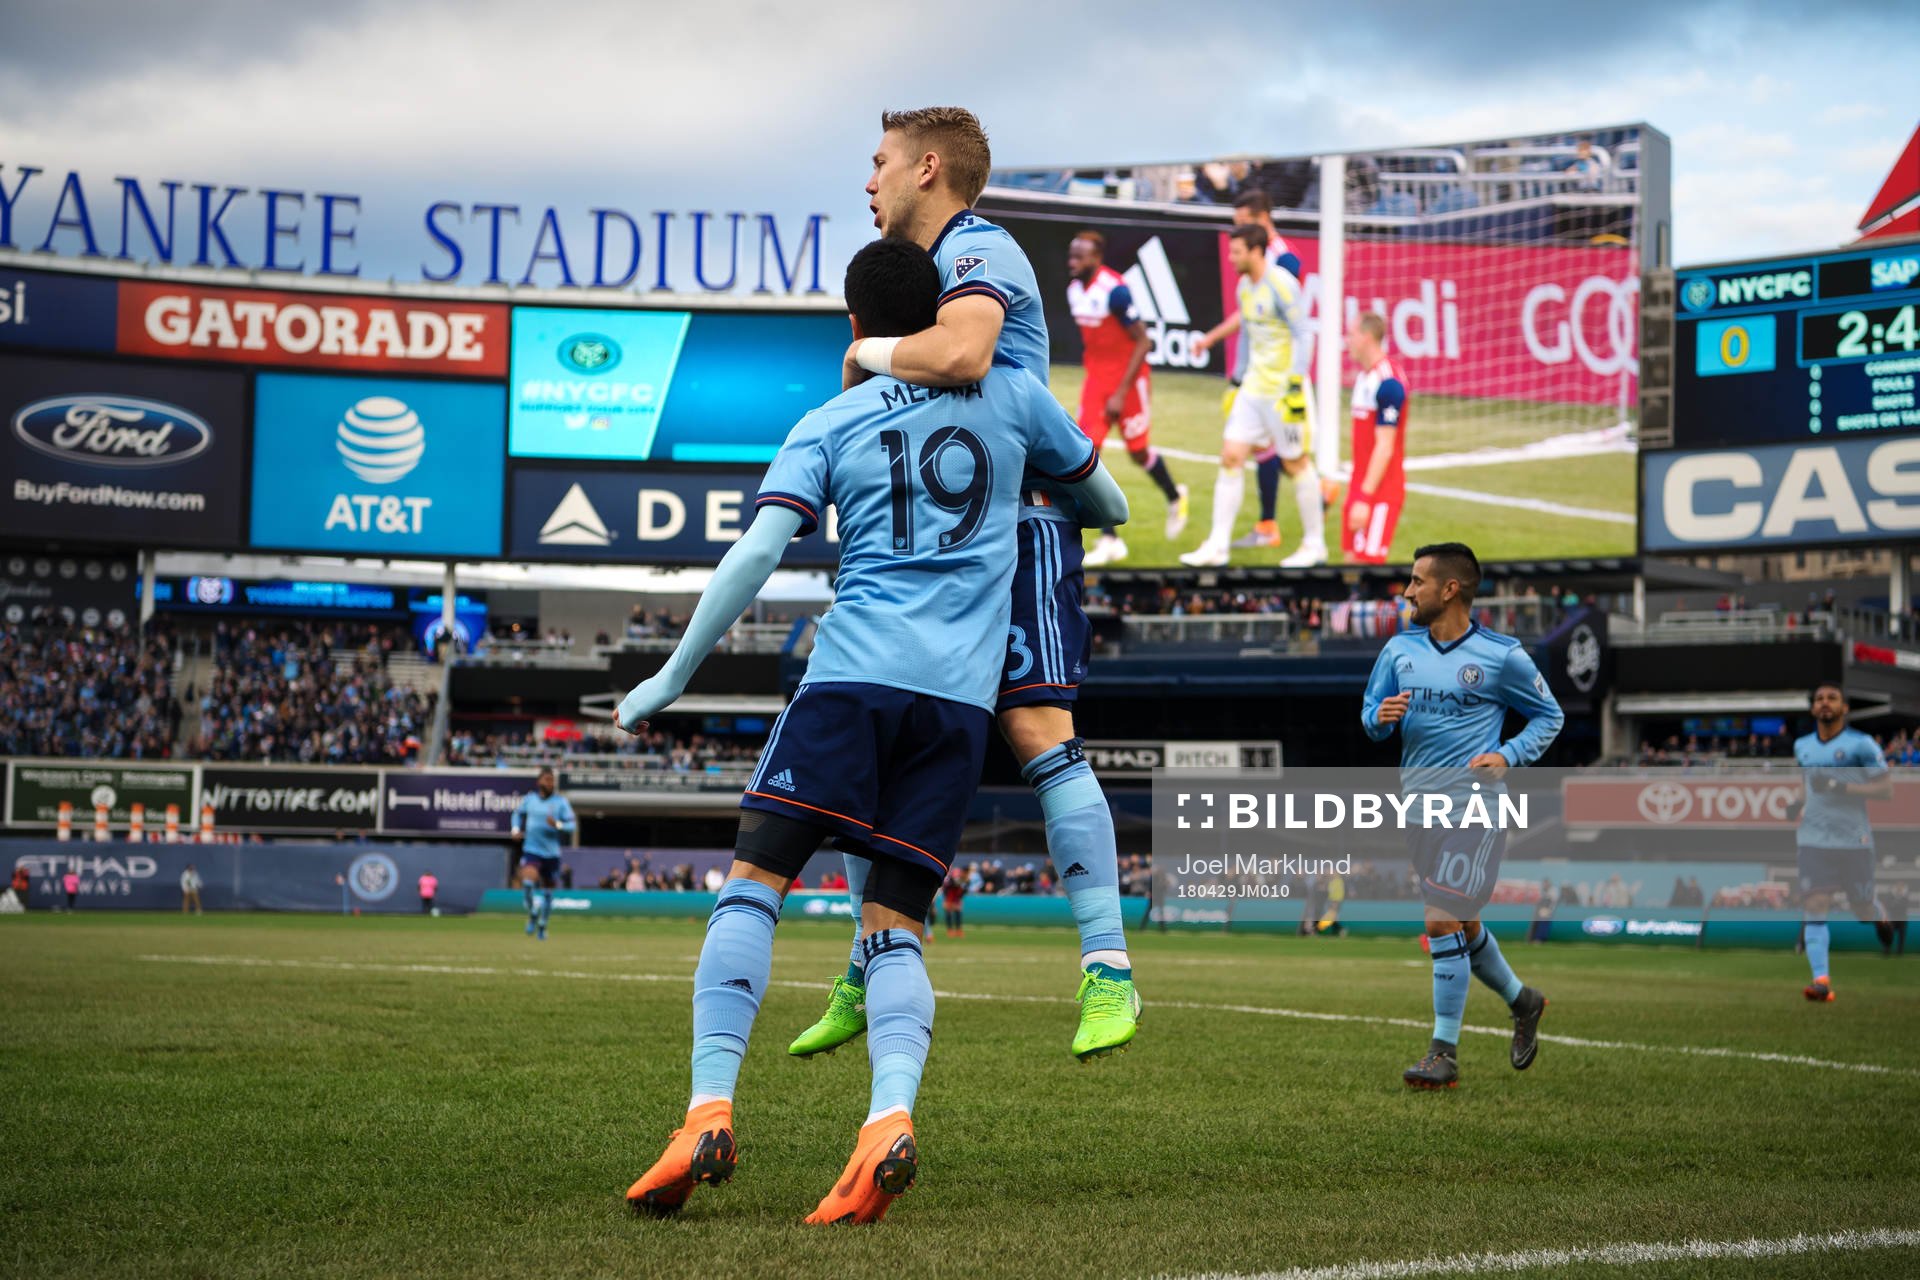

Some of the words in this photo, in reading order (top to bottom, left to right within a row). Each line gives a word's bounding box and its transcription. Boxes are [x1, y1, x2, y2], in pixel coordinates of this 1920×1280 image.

[0, 163, 361, 277] YANKEE
[421, 202, 829, 293] STADIUM
[957, 258, 975, 267] MLS
[1872, 258, 1919, 288] SAP
[1718, 271, 1812, 304] NYCFC
[145, 296, 486, 361] GATORADE
[1720, 325, 1750, 369] 0
[521, 379, 655, 404] #NYCFC
[52, 404, 171, 457] Ford
[14, 479, 205, 512] BuyFordNow.com
[879, 425, 994, 556] 19
[324, 494, 433, 534] AT&T
[1174, 751, 1228, 767] PITCH
[202, 784, 377, 815] NITTOTIRE.COM
[768, 778, 796, 792] adidas
[1697, 786, 1801, 820] TOYO
[15, 854, 157, 878] ETIHAD
[1436, 851, 1470, 888] 10
[40, 880, 131, 895] AIWAYS
